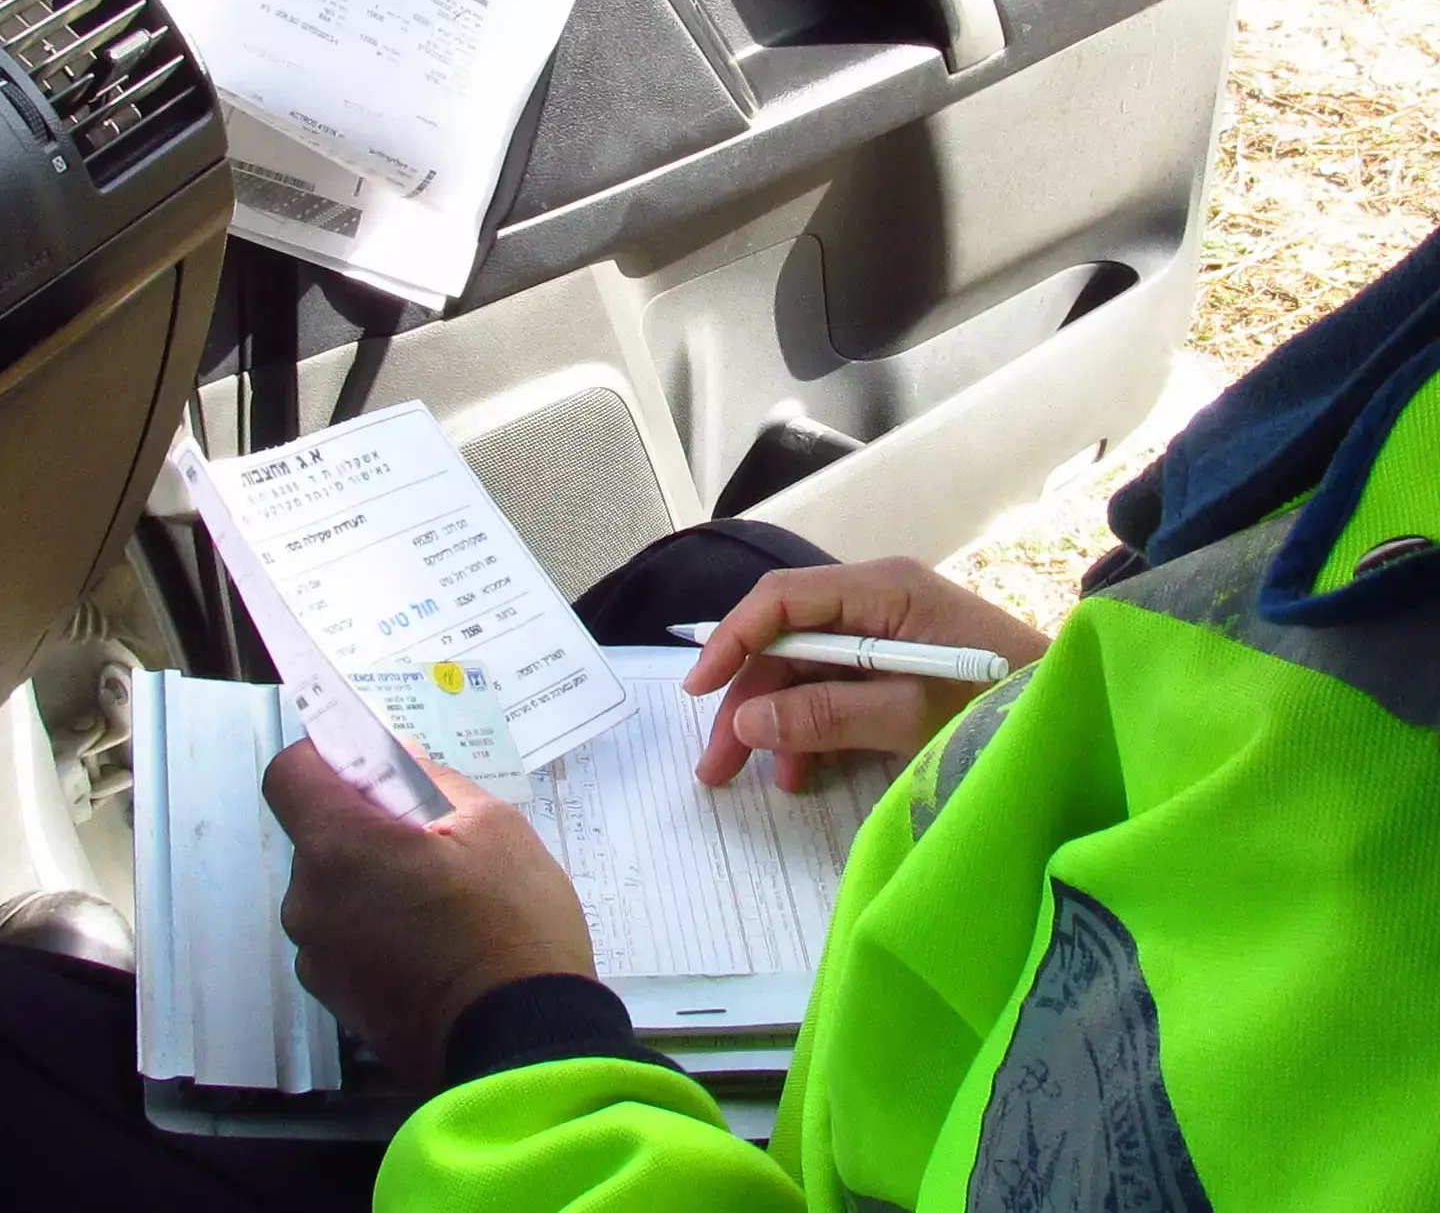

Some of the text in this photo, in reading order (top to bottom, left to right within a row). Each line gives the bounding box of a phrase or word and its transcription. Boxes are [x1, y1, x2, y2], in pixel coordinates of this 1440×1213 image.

[240, 460, 291, 487] מחצבות
[335, 449, 380, 476] אשקלון
[409, 597, 440, 620] חול
[376, 611, 410, 637] טיט
